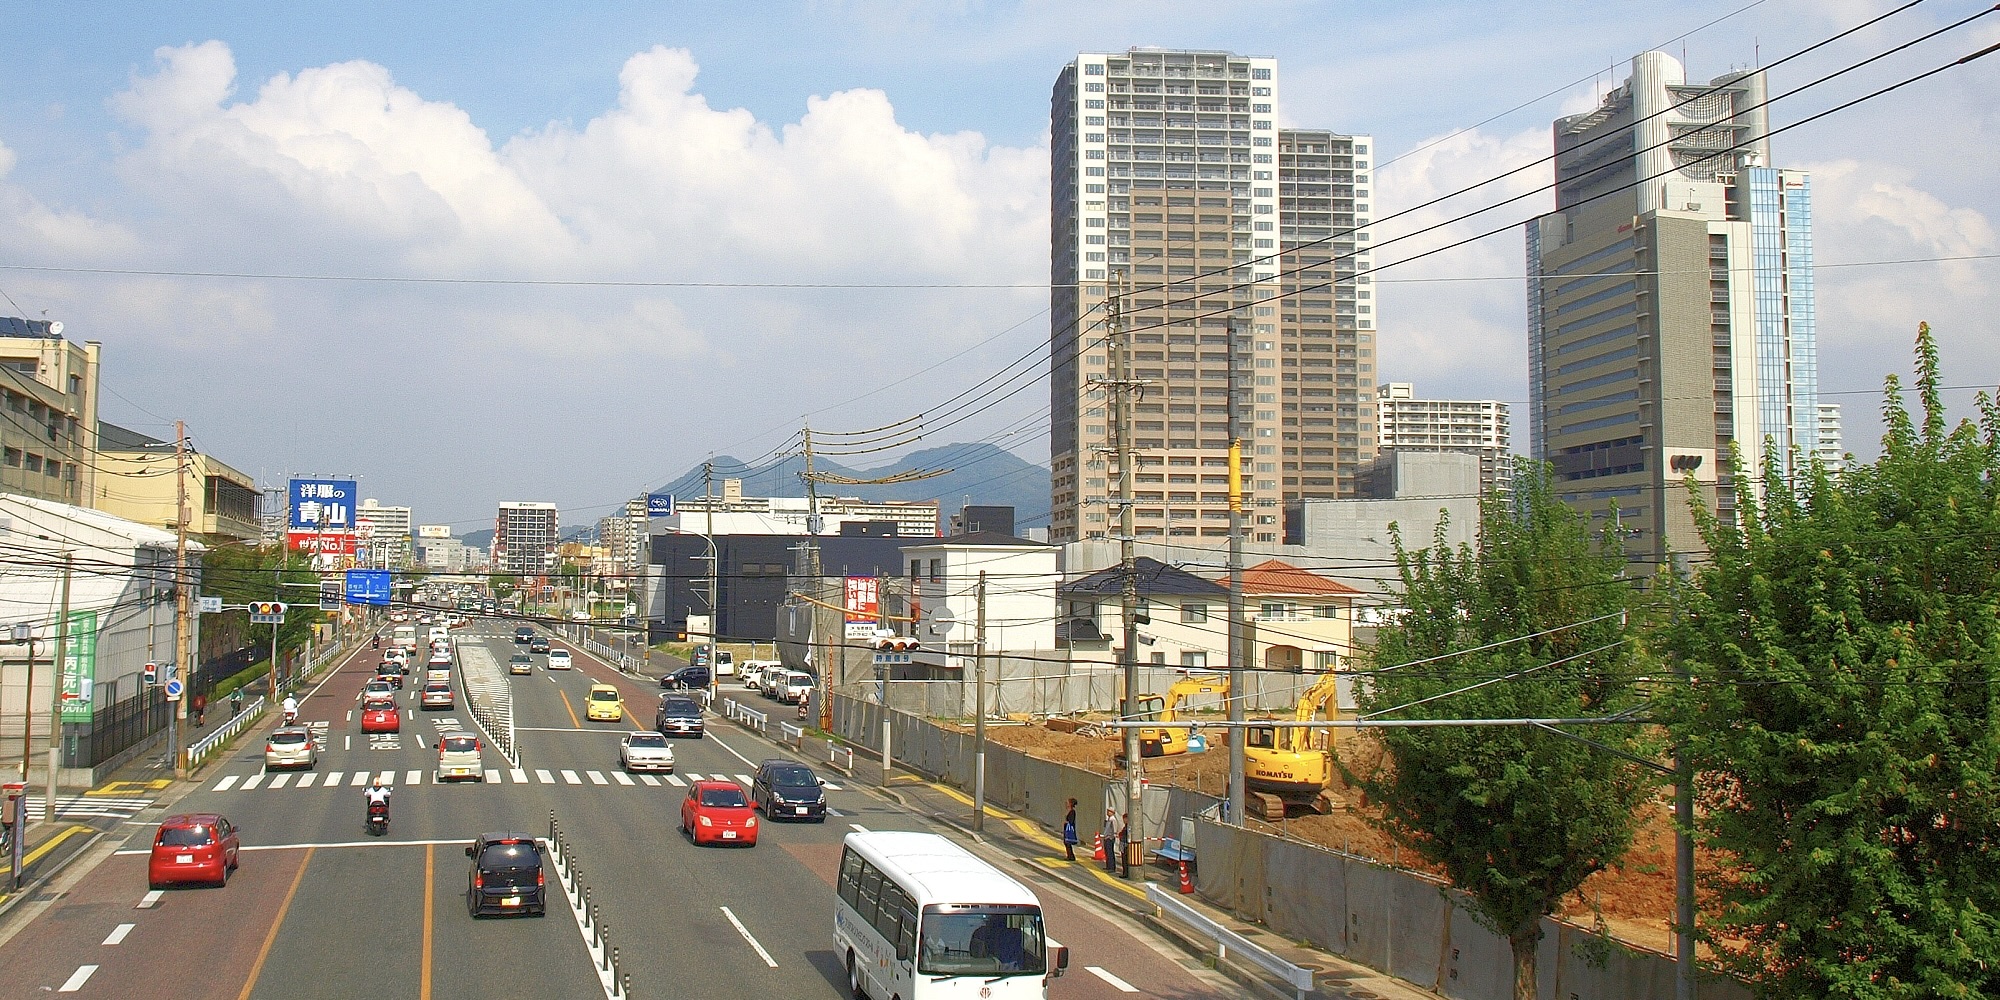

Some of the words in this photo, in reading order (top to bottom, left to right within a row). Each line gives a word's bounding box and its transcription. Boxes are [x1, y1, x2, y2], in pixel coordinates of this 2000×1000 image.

[300, 484, 345, 498] 洋服の
[298, 501, 346, 523] 青山
[1255, 769, 1293, 779] KOMATSU
